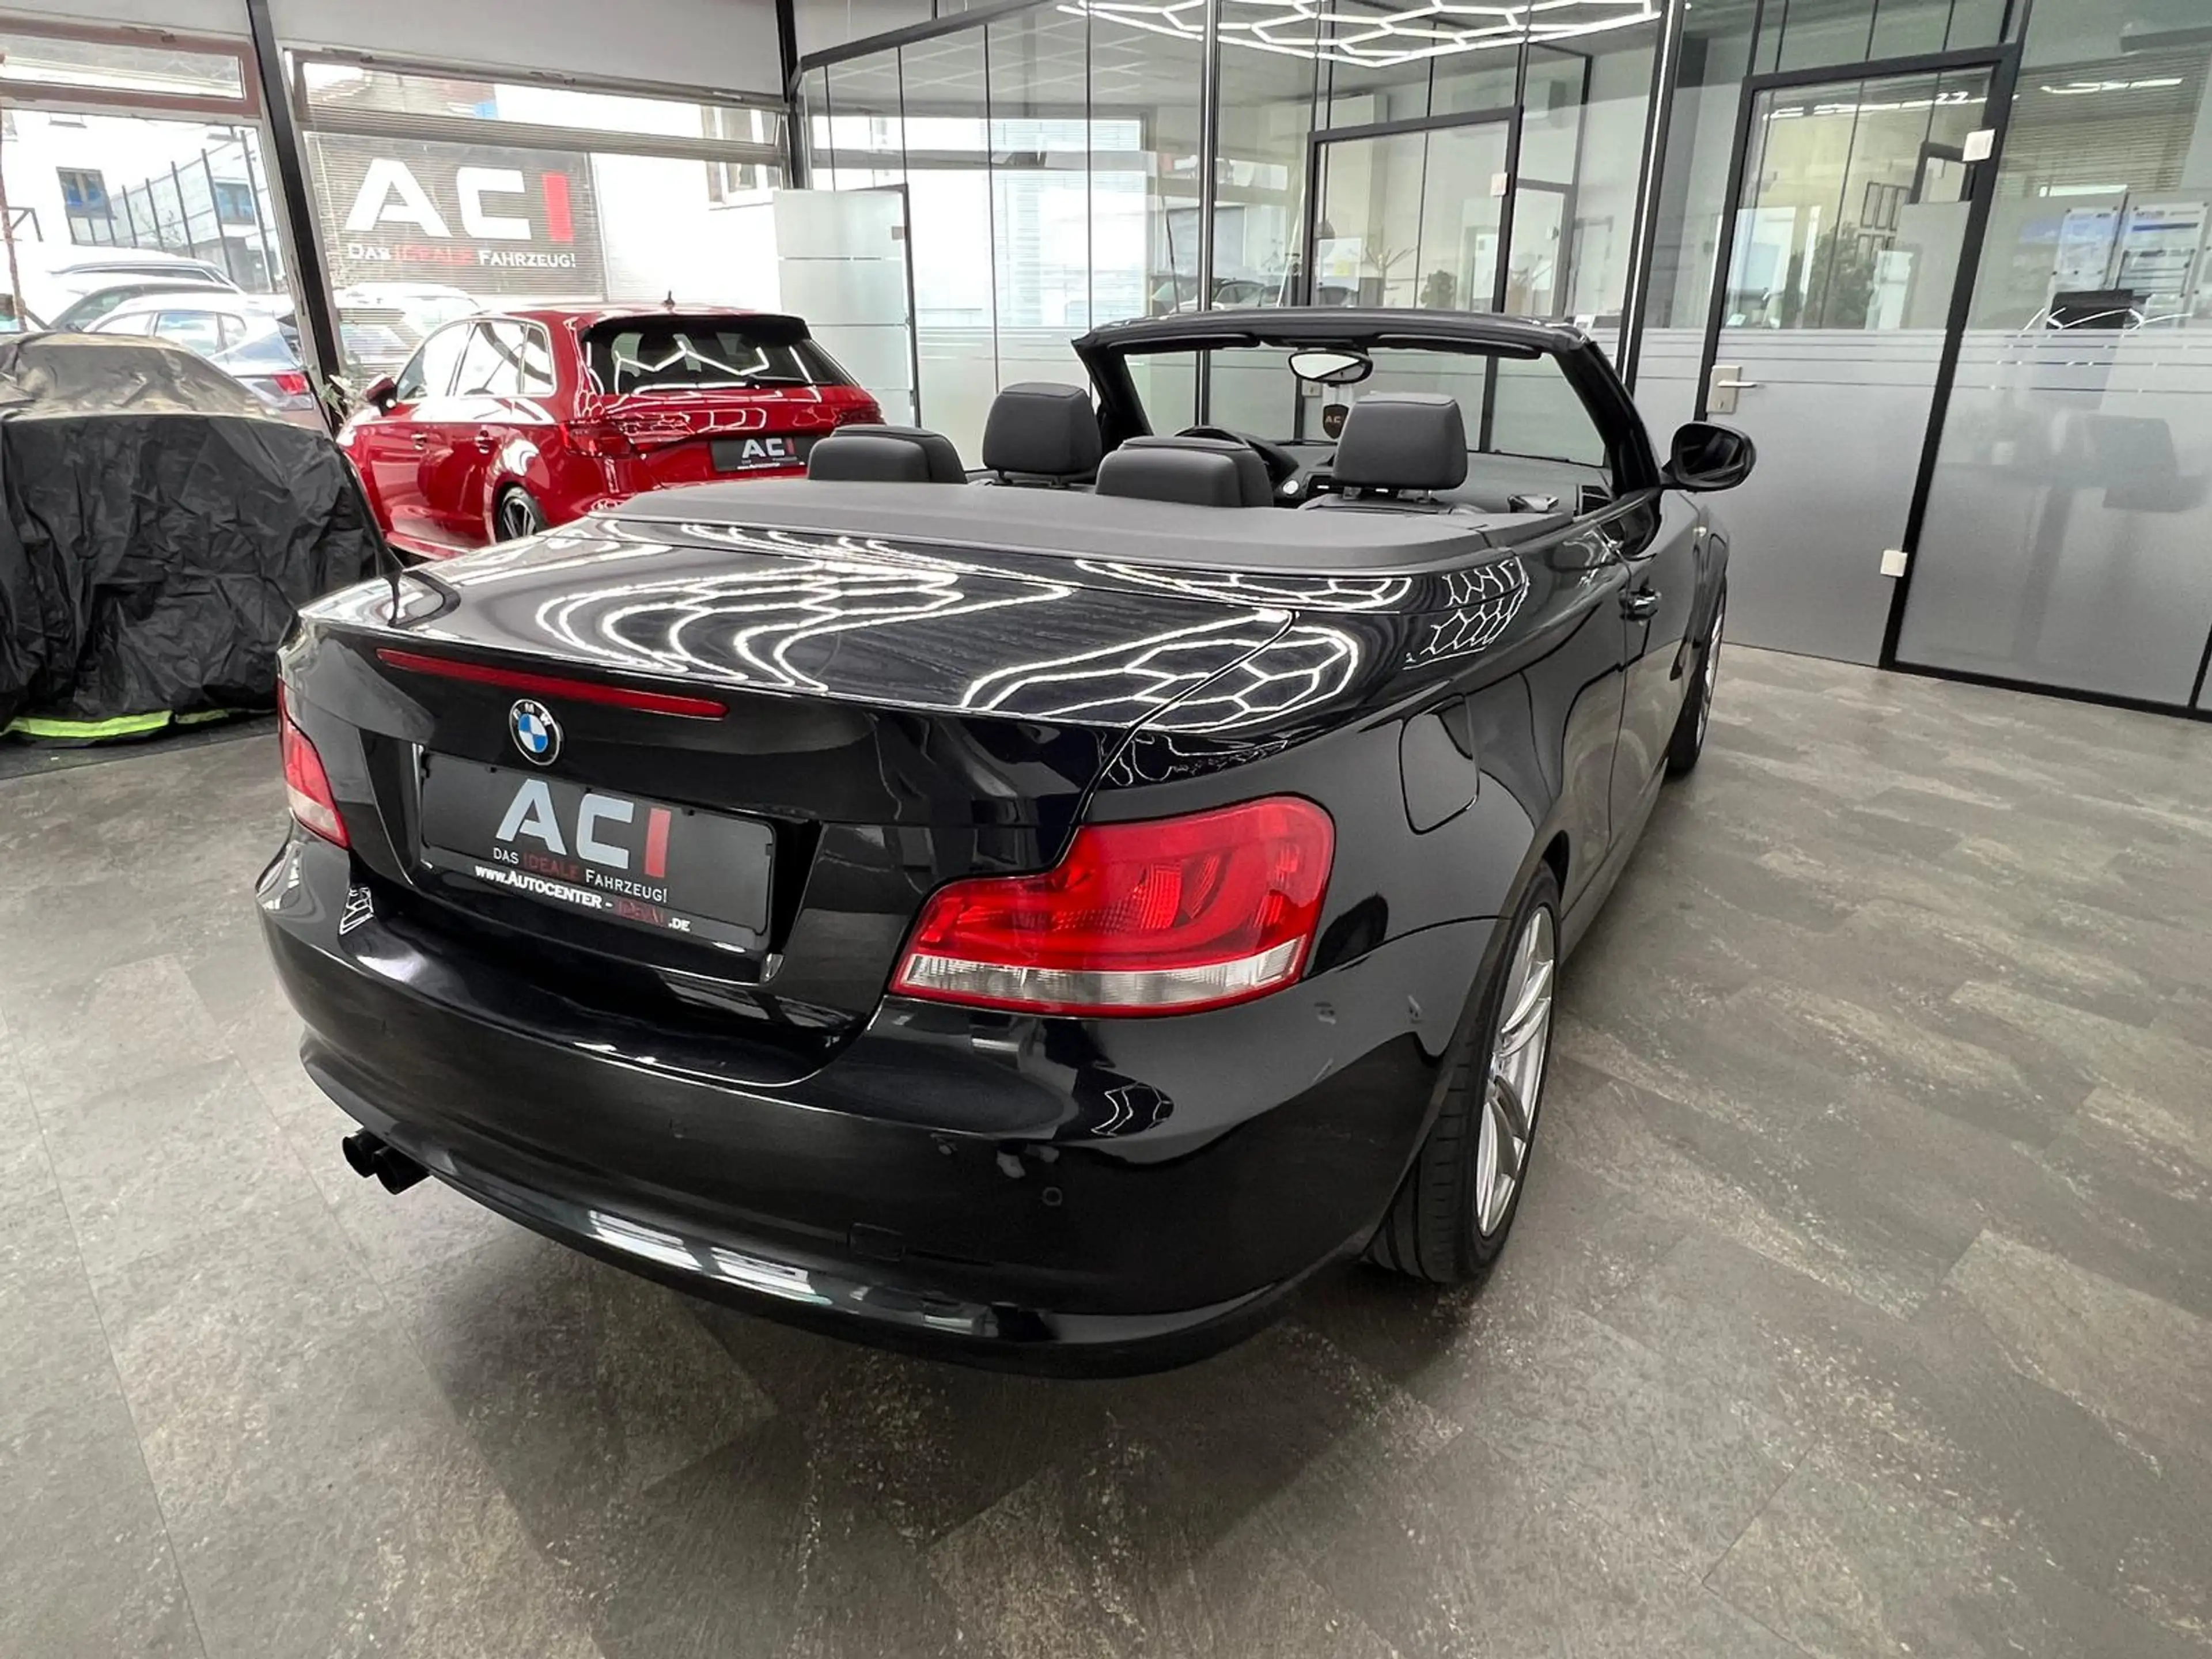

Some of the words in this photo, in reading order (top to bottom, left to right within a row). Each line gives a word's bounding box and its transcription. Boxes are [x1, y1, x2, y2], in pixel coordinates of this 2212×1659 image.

[478, 250, 576, 268] FAHRZEUG!
[513, 702, 551, 726] BMW
[496, 779, 671, 878] ACI
[493, 847, 519, 864] DAS
[523, 852, 579, 880] IDEALE
[586, 869, 667, 903] FAHRZEUG!
